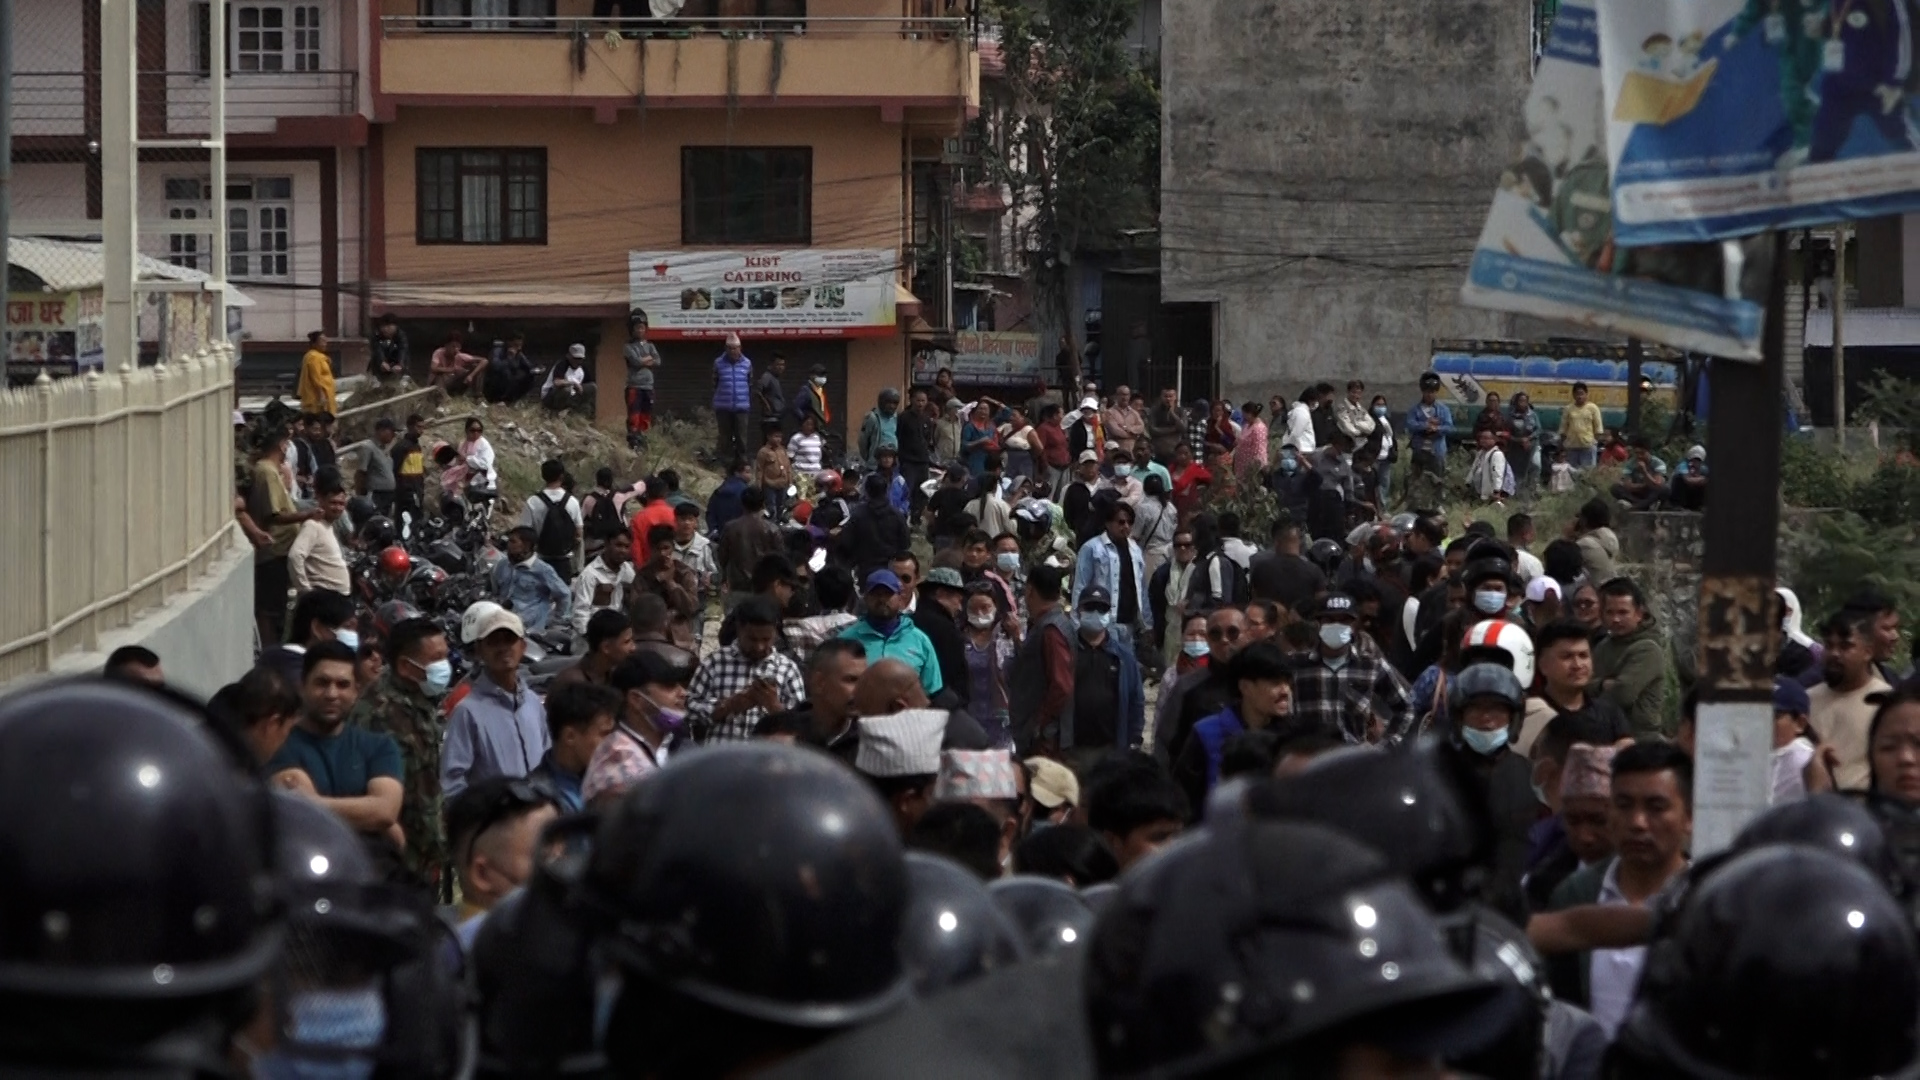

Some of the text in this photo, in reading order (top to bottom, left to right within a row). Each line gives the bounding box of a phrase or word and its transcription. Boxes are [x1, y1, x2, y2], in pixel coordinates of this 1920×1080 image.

[744, 256, 781, 268] KIST
[723, 271, 802, 282] CATERING
[40, 301, 66, 326] घर
